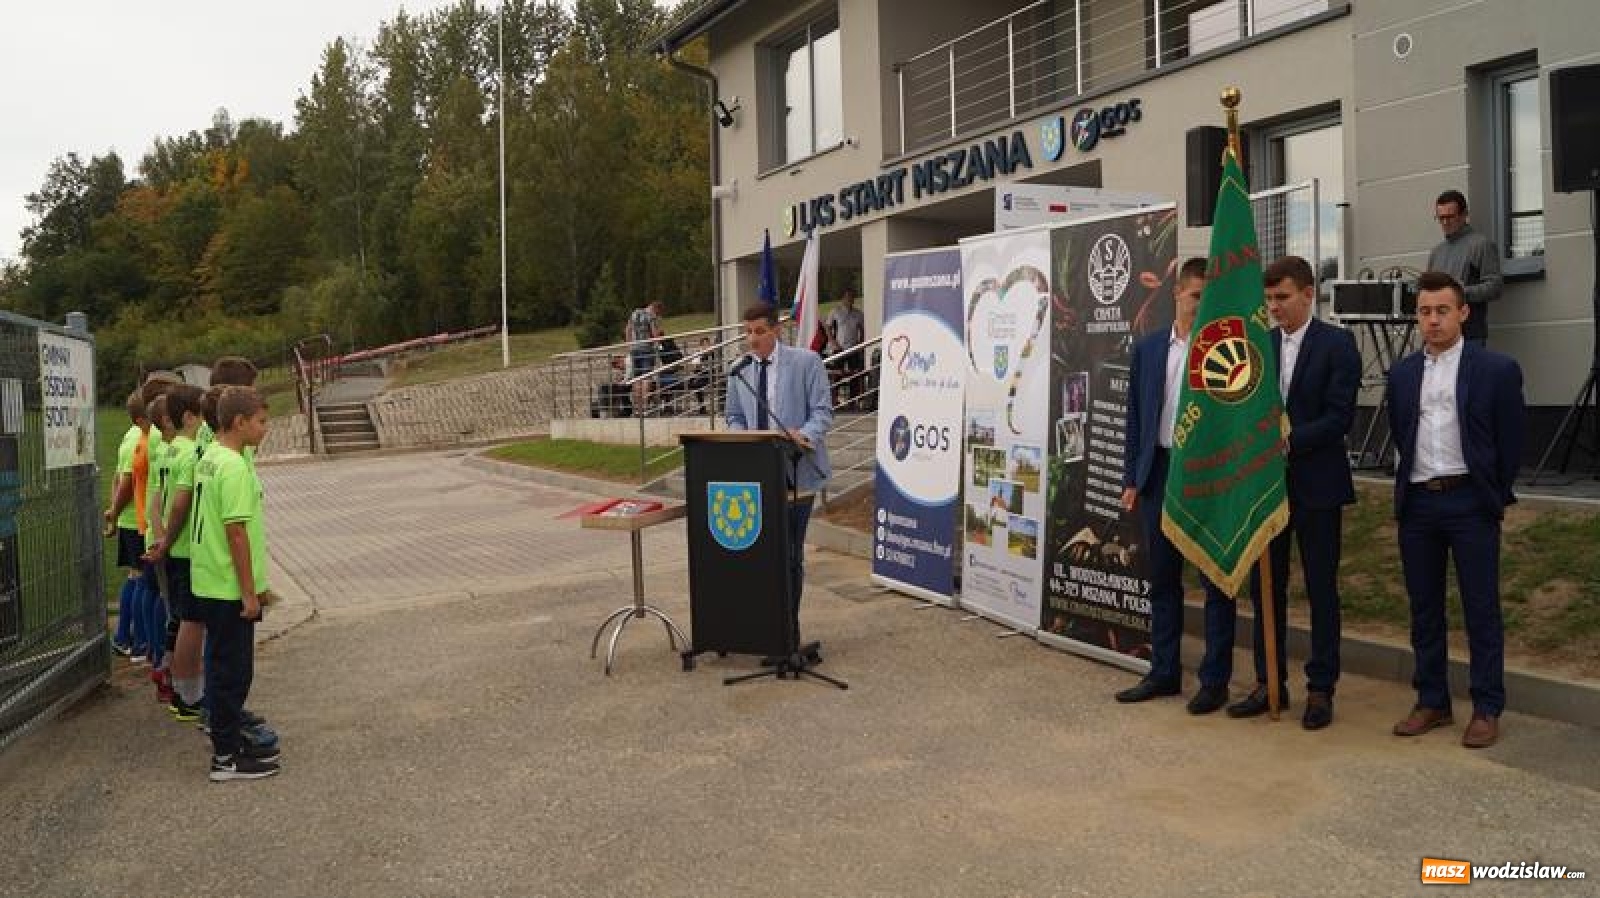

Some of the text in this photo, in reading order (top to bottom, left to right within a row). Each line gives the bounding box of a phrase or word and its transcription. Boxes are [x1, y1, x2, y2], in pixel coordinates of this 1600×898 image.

[1100, 98, 1142, 129] GOS
[800, 193, 835, 233] LKS
[839, 167, 908, 221] START
[912, 130, 1033, 200] MSZANA
[913, 425, 950, 451] GOS
